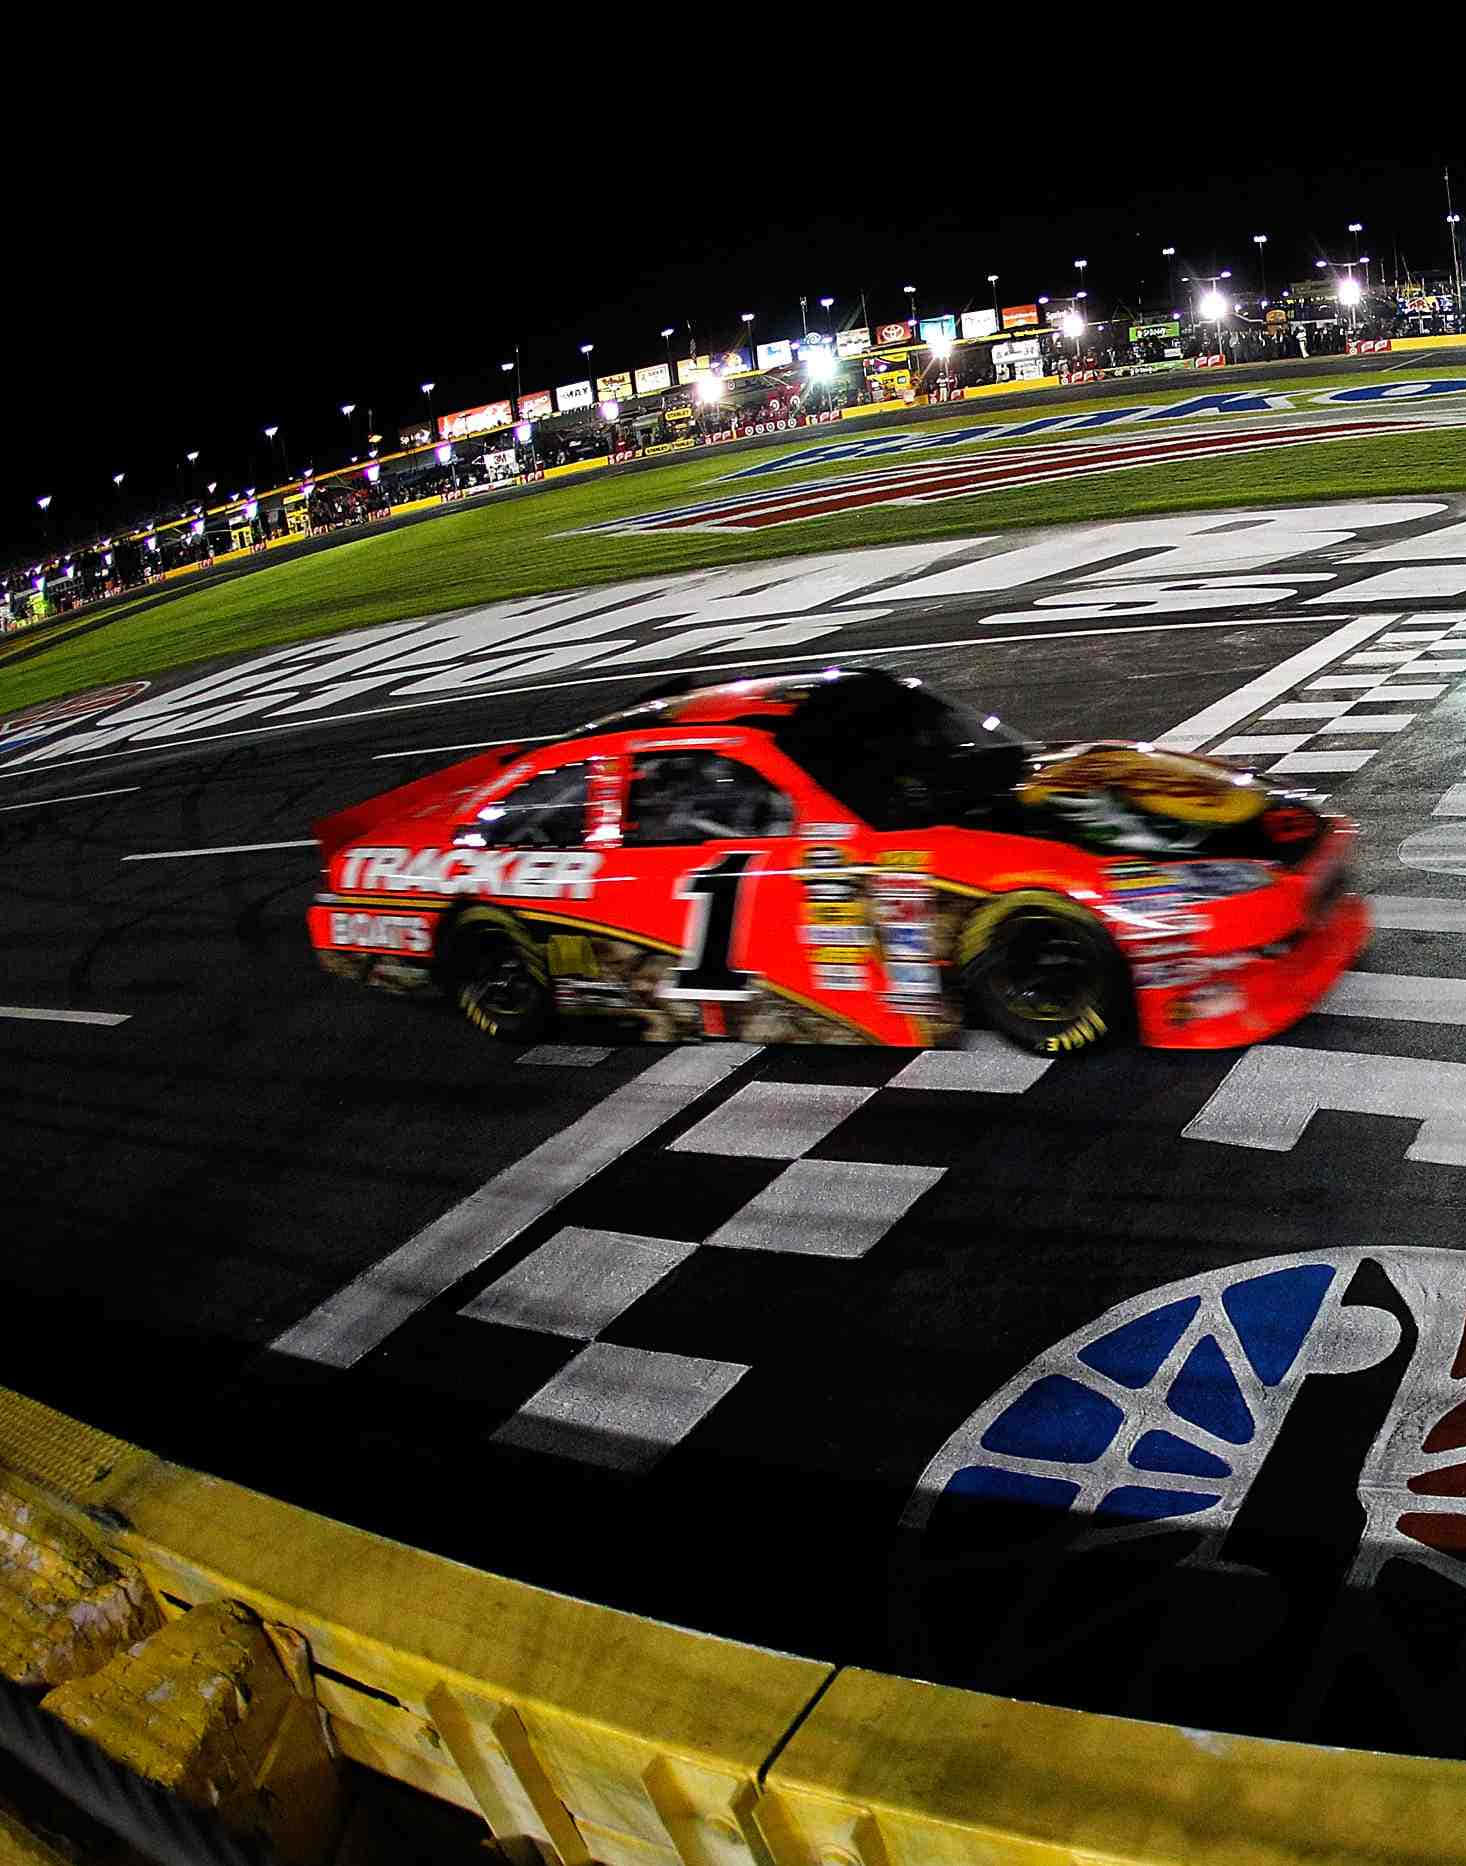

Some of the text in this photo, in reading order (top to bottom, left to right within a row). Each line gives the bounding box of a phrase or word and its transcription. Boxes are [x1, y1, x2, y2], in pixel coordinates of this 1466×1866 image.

[700, 389, 1310, 484] Bank
[338, 846, 604, 900] TRACKER
[329, 910, 433, 953] BOATS
[654, 850, 773, 1002] 1
